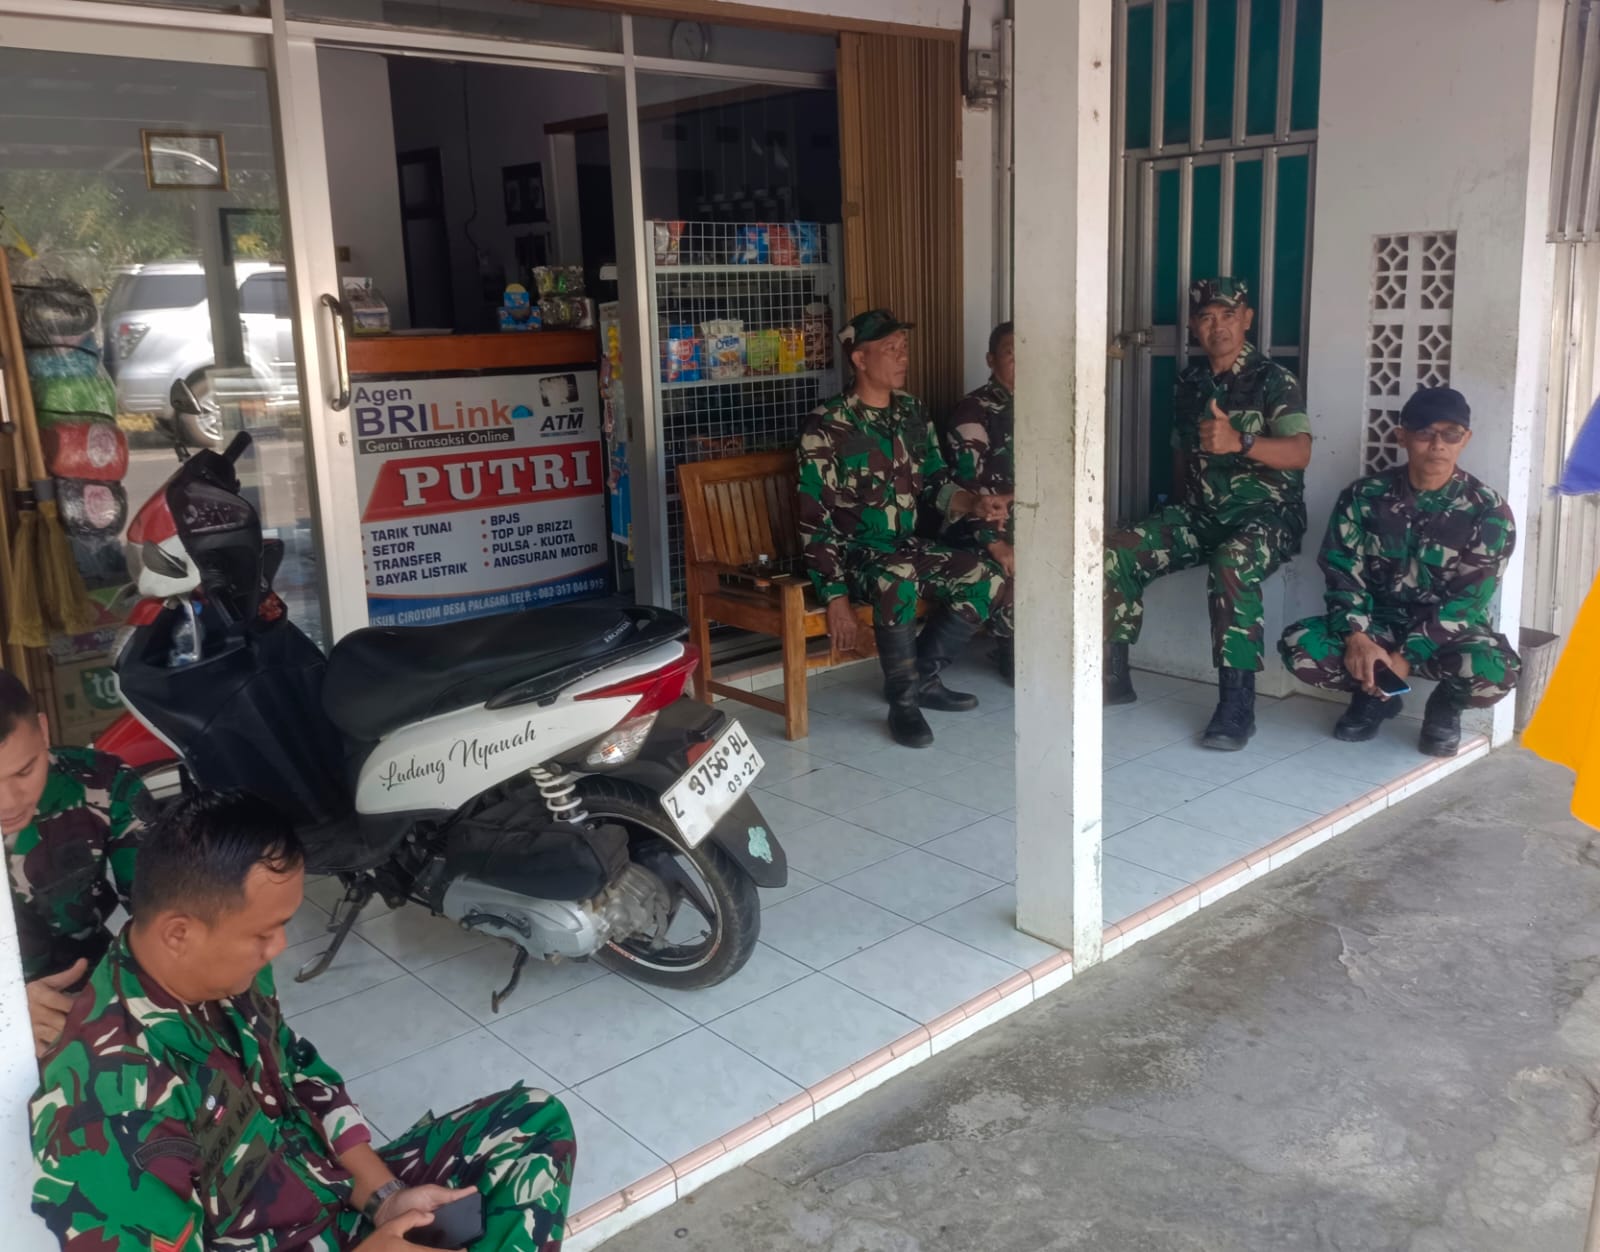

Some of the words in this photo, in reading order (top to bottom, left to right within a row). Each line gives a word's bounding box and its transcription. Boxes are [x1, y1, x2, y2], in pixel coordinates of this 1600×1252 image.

[355, 386, 412, 406] Agen
[355, 399, 513, 437] BRILink
[540, 413, 584, 431] ATM
[366, 440, 403, 453] Gerai
[407, 432, 465, 449] Transaksi
[468, 430, 509, 443] Online
[399, 450, 592, 506] PUTRI
[490, 512, 520, 526] BPJS
[491, 527, 513, 540] TOP
[517, 524, 533, 536] UP
[537, 519, 572, 534] BRIZZI
[371, 526, 409, 542] TARIK
[412, 521, 452, 536] TUNAI
[372, 541, 415, 557] SETOR
[492, 540, 530, 554] PULSA
[540, 533, 575, 547] KUOTA
[374, 551, 442, 571] TRANSFER
[493, 549, 557, 568] ANGSURAN
[561, 543, 598, 558] MOTOR
[376, 569, 418, 586] BAYAR
[421, 562, 468, 579] LISTRIK
[368, 613, 395, 627] USUN
[398, 606, 441, 624] CIROYOM
[443, 601, 466, 616] DESA
[468, 592, 509, 611] PALASARI
[557, 583, 571, 596] 317
[668, 797, 685, 819] Z
[728, 732, 748, 755] BL
